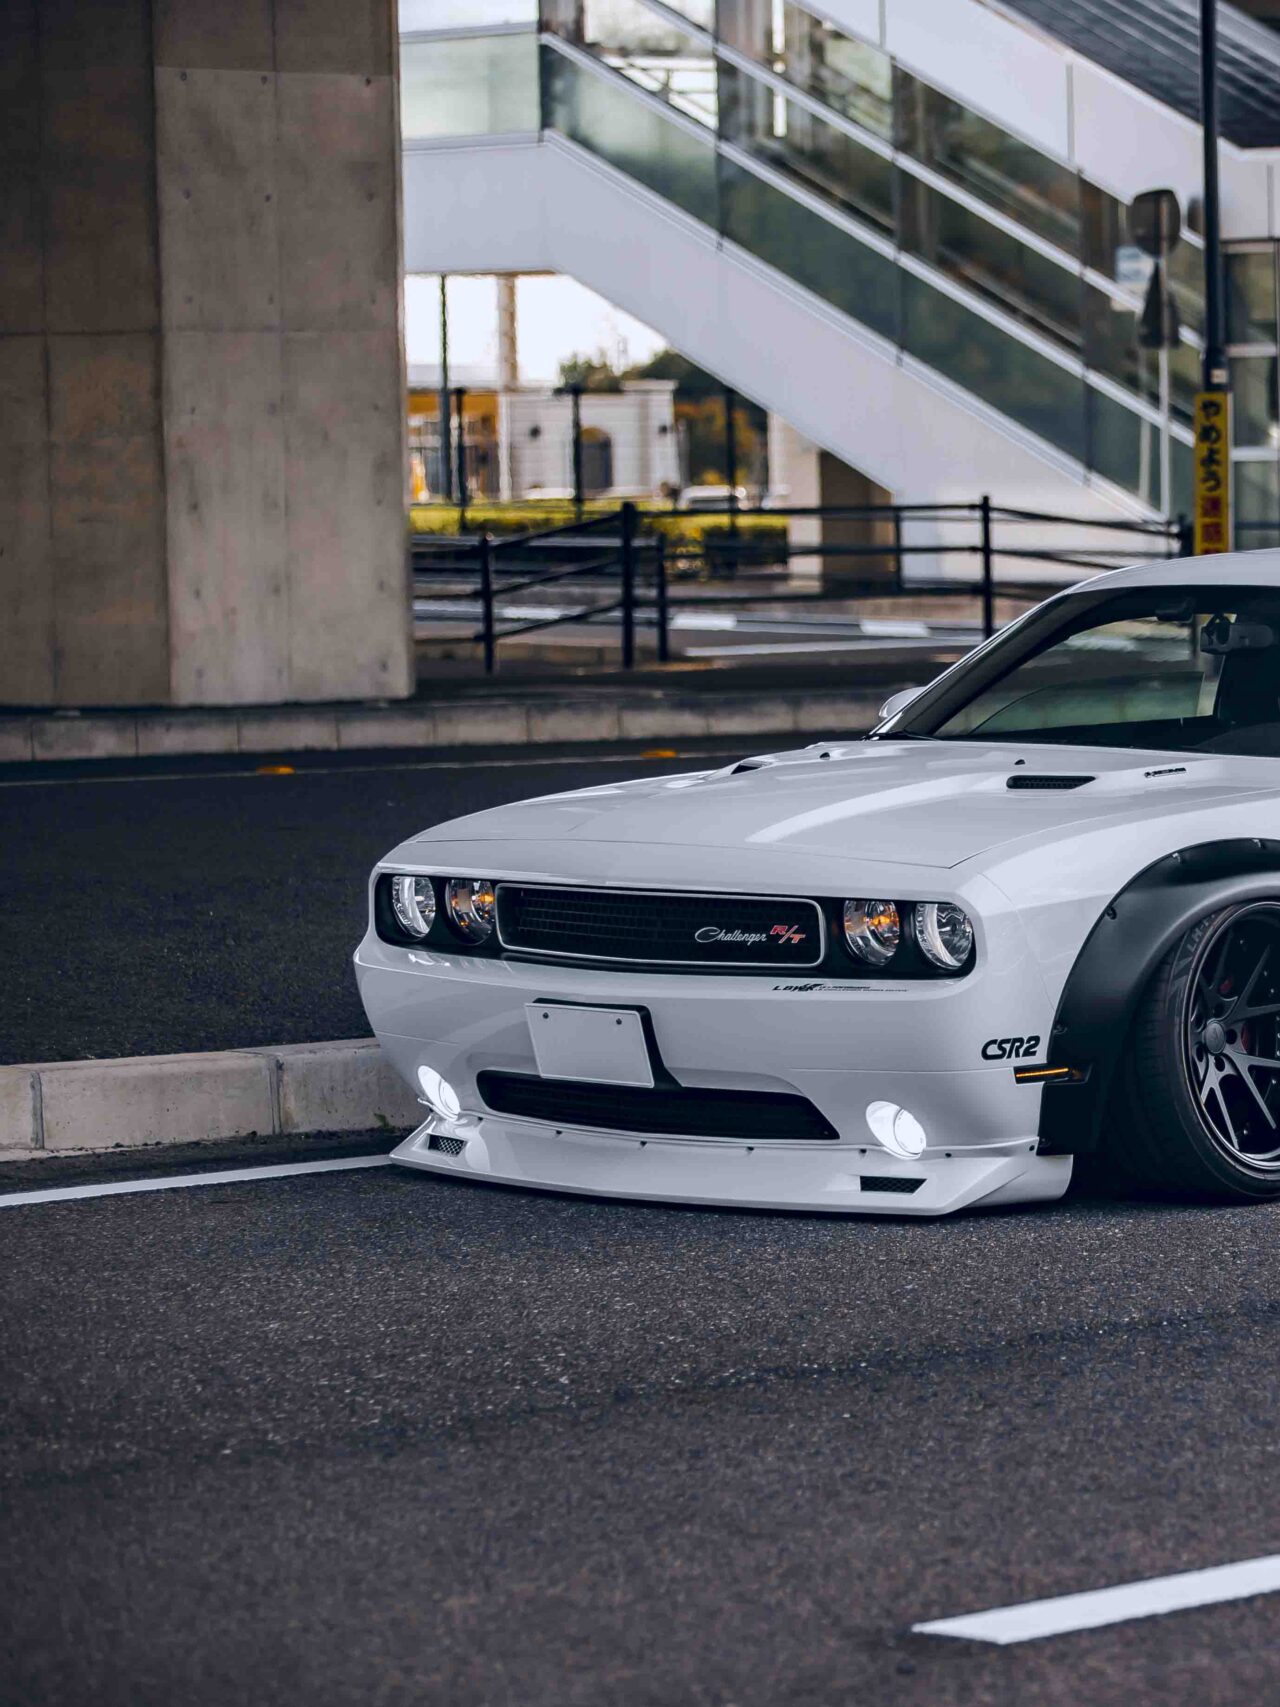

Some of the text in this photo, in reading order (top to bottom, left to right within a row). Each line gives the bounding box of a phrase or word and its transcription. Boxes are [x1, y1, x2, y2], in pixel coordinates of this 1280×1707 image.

[694, 924, 806, 946] Challenger R/T
[981, 1035, 1041, 1060] CSR2
